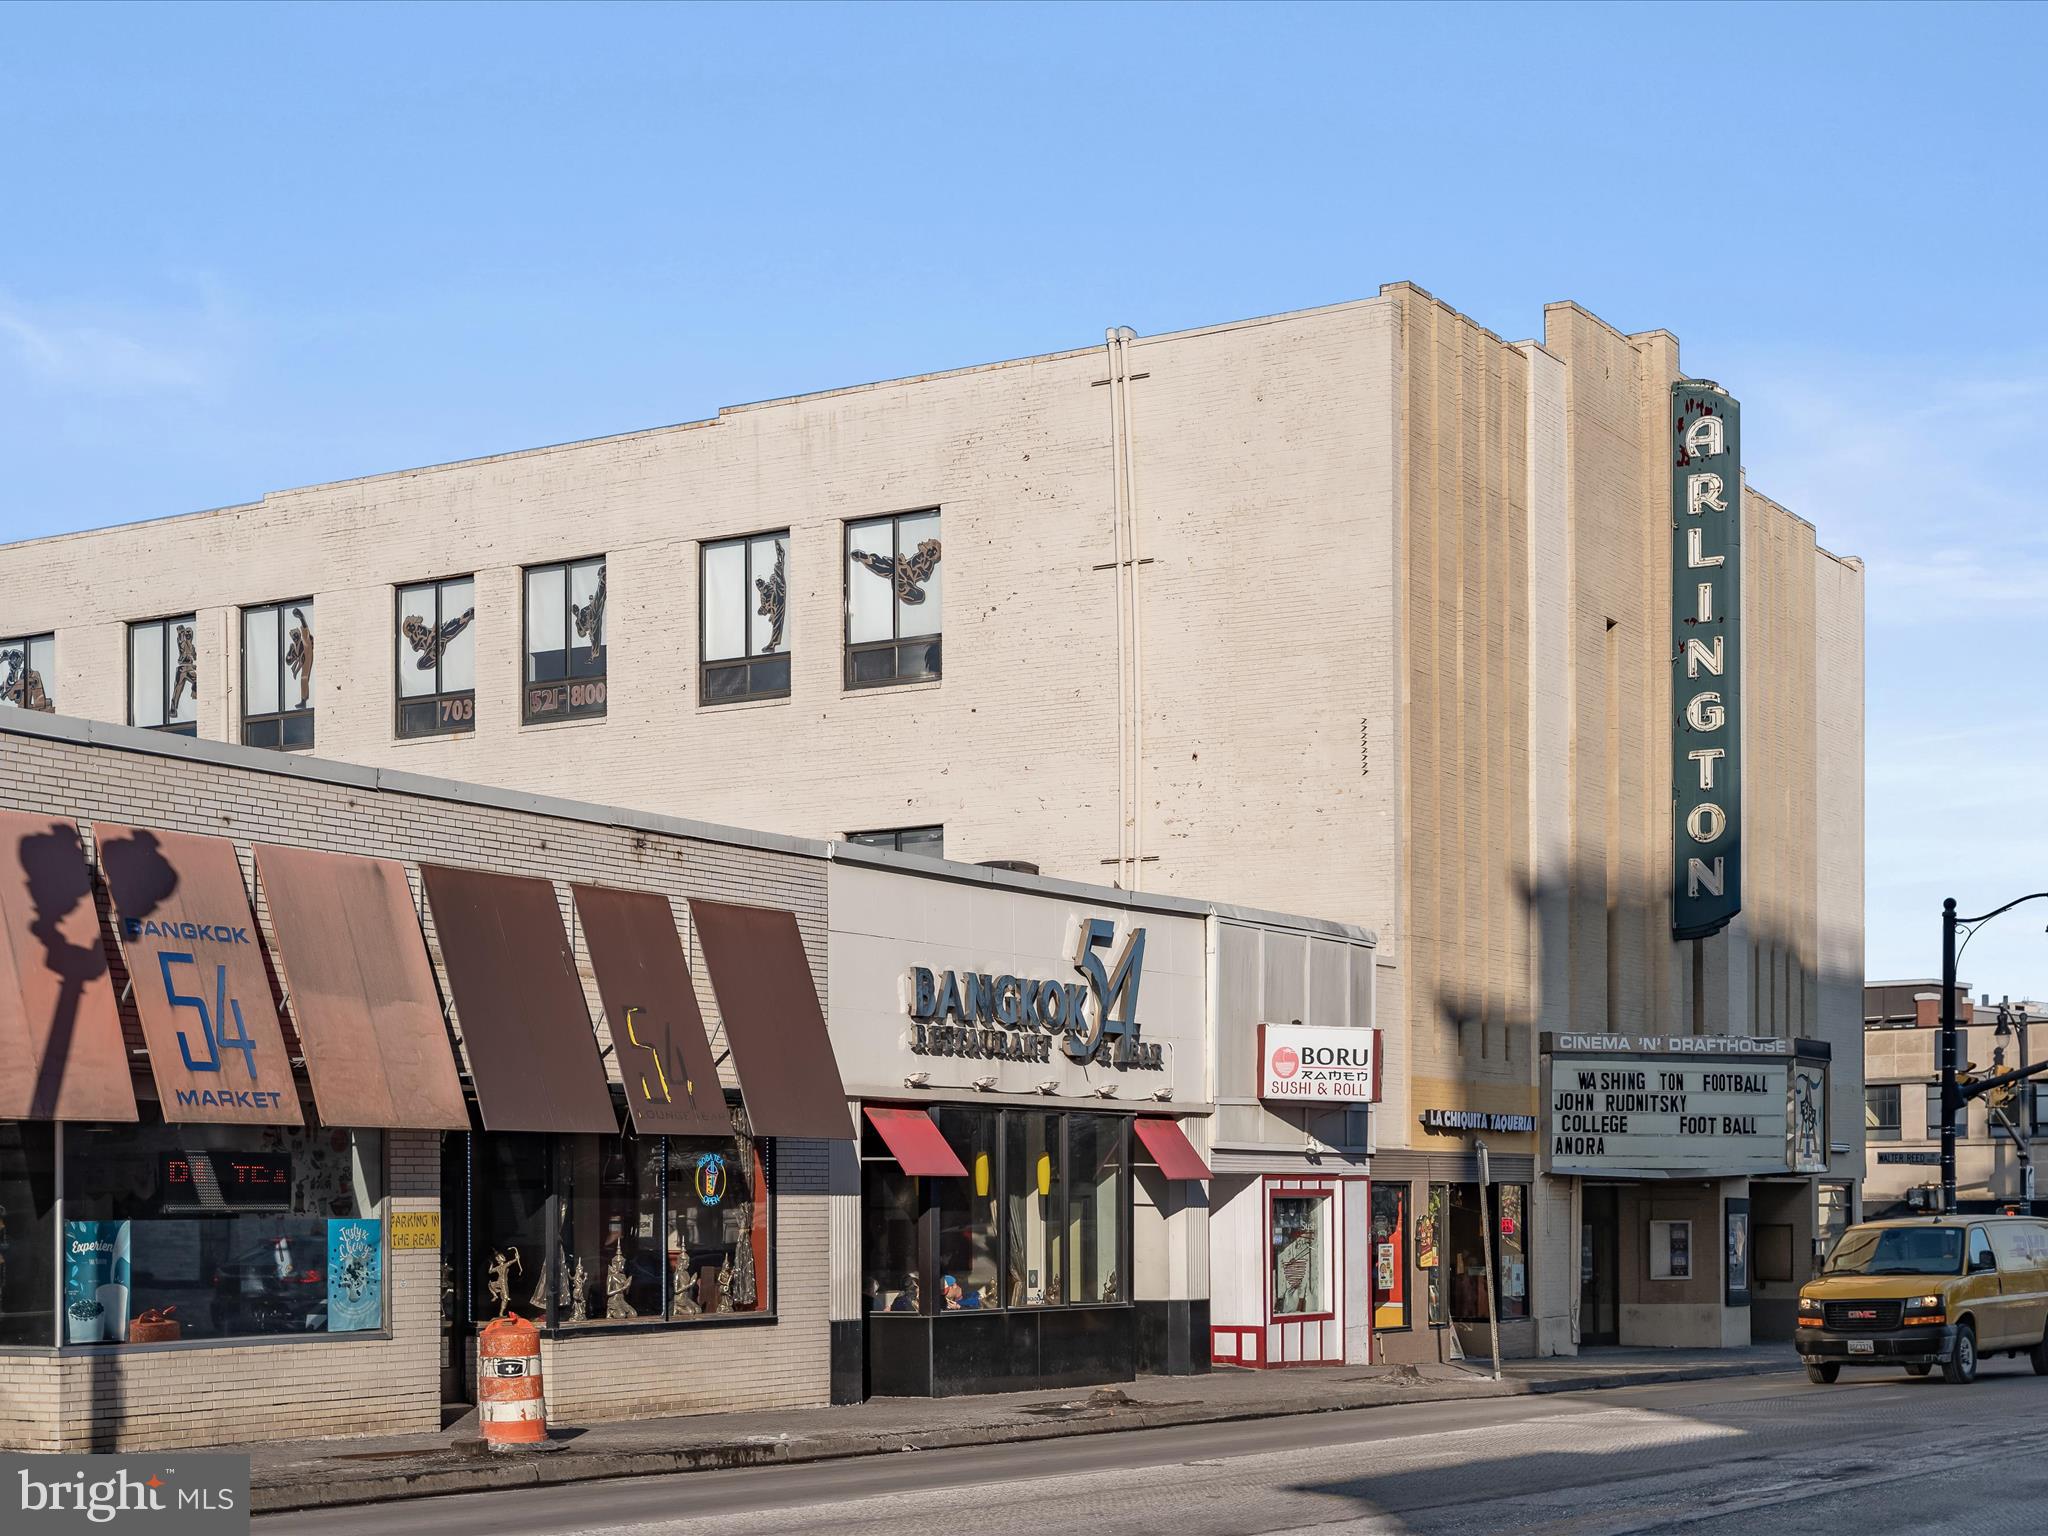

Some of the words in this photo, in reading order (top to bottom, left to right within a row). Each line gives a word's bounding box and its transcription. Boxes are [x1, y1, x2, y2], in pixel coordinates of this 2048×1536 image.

[1685, 415, 1728, 899] ARLINGTON
[442, 699, 473, 721] 703
[125, 917, 249, 944] BANGKOK
[909, 967, 1089, 1035] BANGKOK
[1061, 918, 1146, 1065] 54
[158, 951, 256, 1081] 54
[910, 1023, 1052, 1060] RESTAURANT
[1559, 1035, 1631, 1050] CINEMA
[1669, 1038, 1786, 1053] DRAFTHOUSE
[1301, 1047, 1368, 1066] BORU
[1301, 1070, 1368, 1081] RAMEN
[1703, 1074, 1768, 1093] FOOTBALL
[1271, 1081, 1311, 1094] SUSHI
[1317, 1082, 1328, 1095] &
[1334, 1083, 1366, 1096] ROLL
[175, 1088, 281, 1109] MARKET
[1555, 1094, 1594, 1112] JOHN
[1605, 1094, 1687, 1113] RUDNITSKY
[1430, 1110, 1443, 1126] LA
[1444, 1110, 1488, 1130] CHIQUITA
[1490, 1115, 1533, 1132] TAQUERIA
[1562, 1115, 1628, 1133] COLLEGE
[1555, 1136, 1605, 1155] ANORA
[1879, 1153, 1904, 1163] WALTER
[1906, 1153, 1925, 1163] REED
[703, 1195, 720, 1205] OPEN
[391, 1214, 428, 1228] PARKING
[431, 1214, 440, 1228] IN
[339, 1222, 363, 1241] Tasty
[393, 1233, 410, 1247] THE
[413, 1233, 436, 1246] REAR
[1848, 1310, 1877, 1318] GMC
